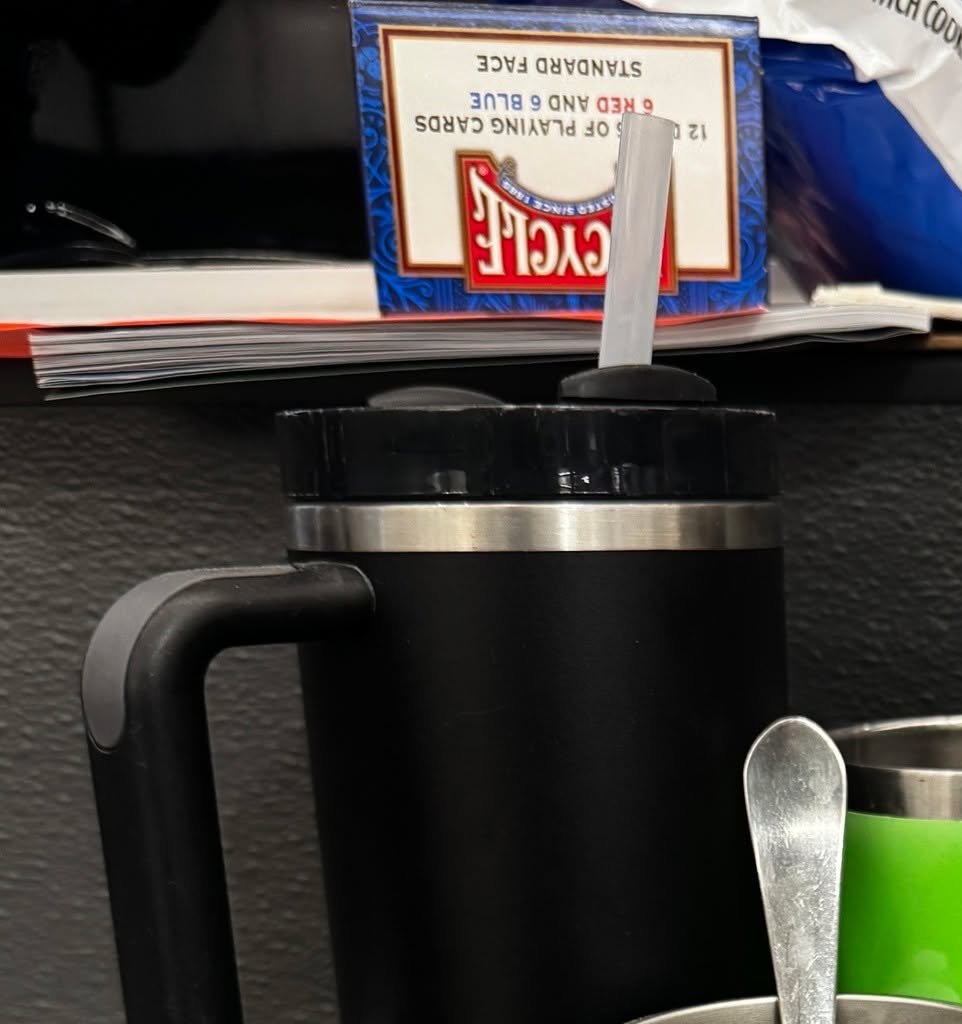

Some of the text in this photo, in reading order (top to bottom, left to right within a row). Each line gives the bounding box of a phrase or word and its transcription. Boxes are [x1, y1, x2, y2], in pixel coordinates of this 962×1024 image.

[477, 55, 642, 78] STANDARD FACE
[470, 92, 654, 114] 6 RED AND 6 BLUE
[415, 115, 484, 134] CARDS
[492, 116, 576, 137] PLAYING
[585, 120, 609, 136] OF
[689, 123, 708, 140] 12
[469, 166, 612, 277] CYCLE
